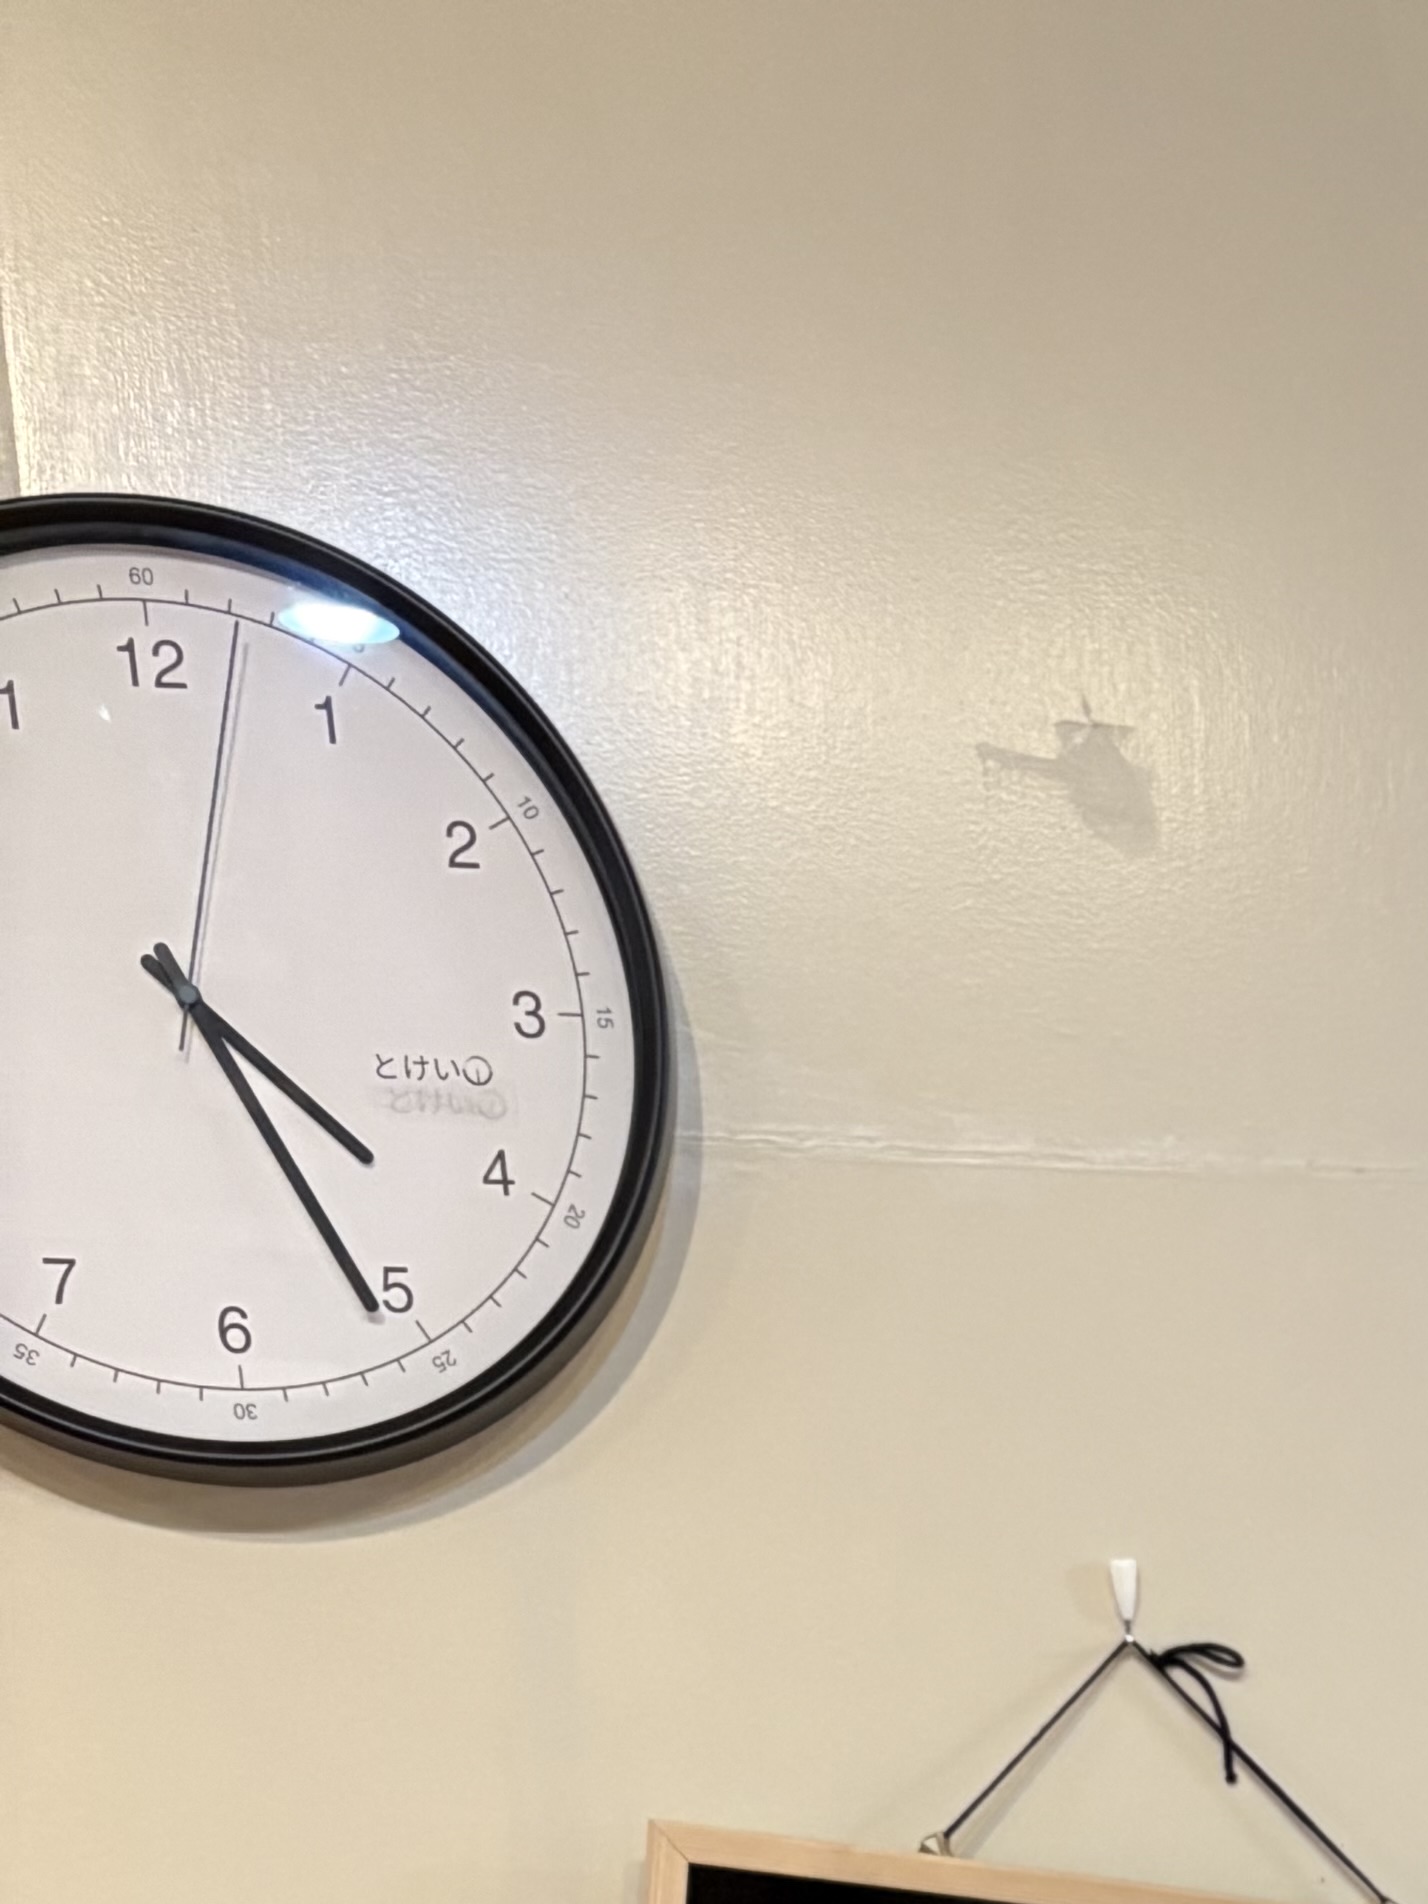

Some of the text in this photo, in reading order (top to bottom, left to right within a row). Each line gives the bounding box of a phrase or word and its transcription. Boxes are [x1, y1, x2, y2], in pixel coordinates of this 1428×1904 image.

[129, 566, 154, 586] 60
[116, 636, 188, 689] 12
[0, 679, 20, 730] 1
[314, 695, 337, 745] 1
[517, 795, 540, 820] 10
[445, 820, 481, 869] 2
[512, 989, 546, 1039] 3
[596, 1006, 615, 1030] 15
[375, 1053, 461, 1081] とけい
[482, 1148, 516, 1196] 4
[562, 1203, 586, 1230] 20
[42, 1257, 77, 1304] 7
[381, 1266, 414, 1313] 5
[217, 1306, 252, 1353] 6
[13, 1342, 40, 1367] 35
[431, 1349, 458, 1374] 25
[232, 1402, 259, 1421] 30
